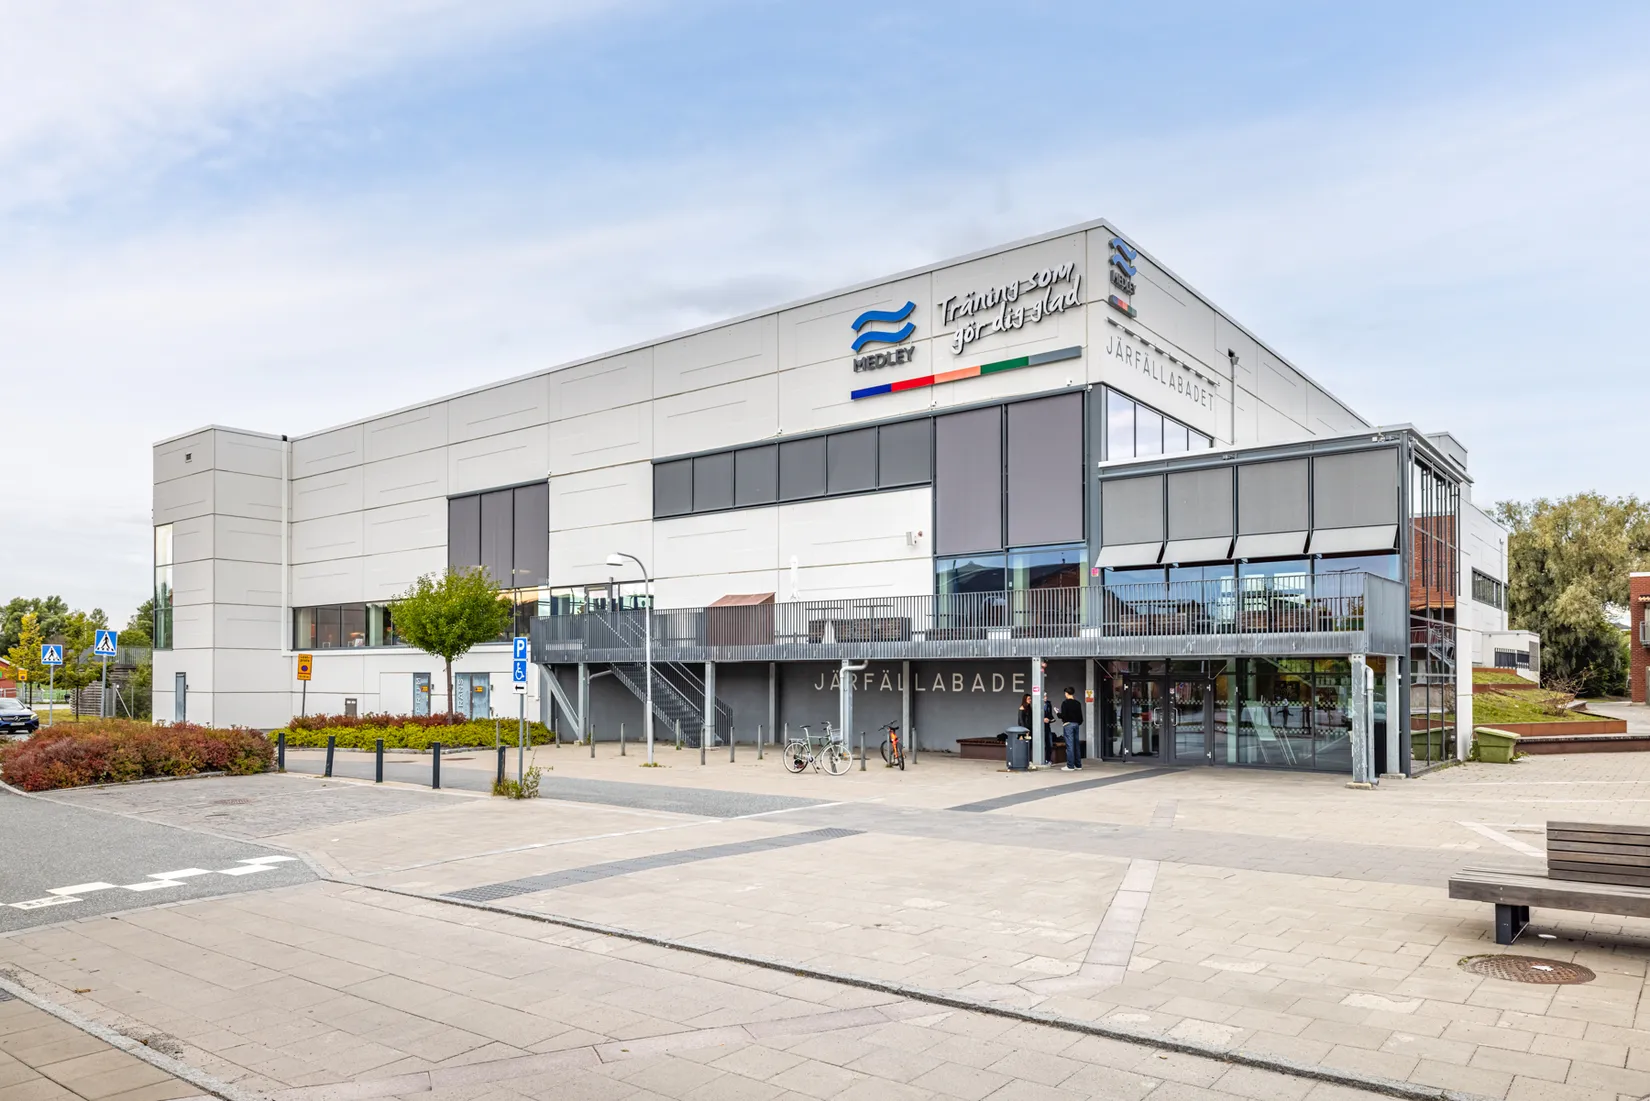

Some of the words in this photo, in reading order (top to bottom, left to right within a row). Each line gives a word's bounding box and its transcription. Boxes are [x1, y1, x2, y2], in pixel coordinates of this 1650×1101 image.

[937, 279, 1020, 326] Träning
[1025, 261, 1074, 293] som
[1110, 269, 1136, 296] MEDLEY
[951, 320, 986, 355] gör
[992, 301, 1025, 332] dig
[1030, 274, 1082, 323] glad
[853, 346, 916, 374] MEDLEY
[1106, 336, 1214, 411] JÄRFÄLLABADET
[516, 639, 525, 658] P
[814, 669, 1048, 692] JÄRFÄLLABADE
